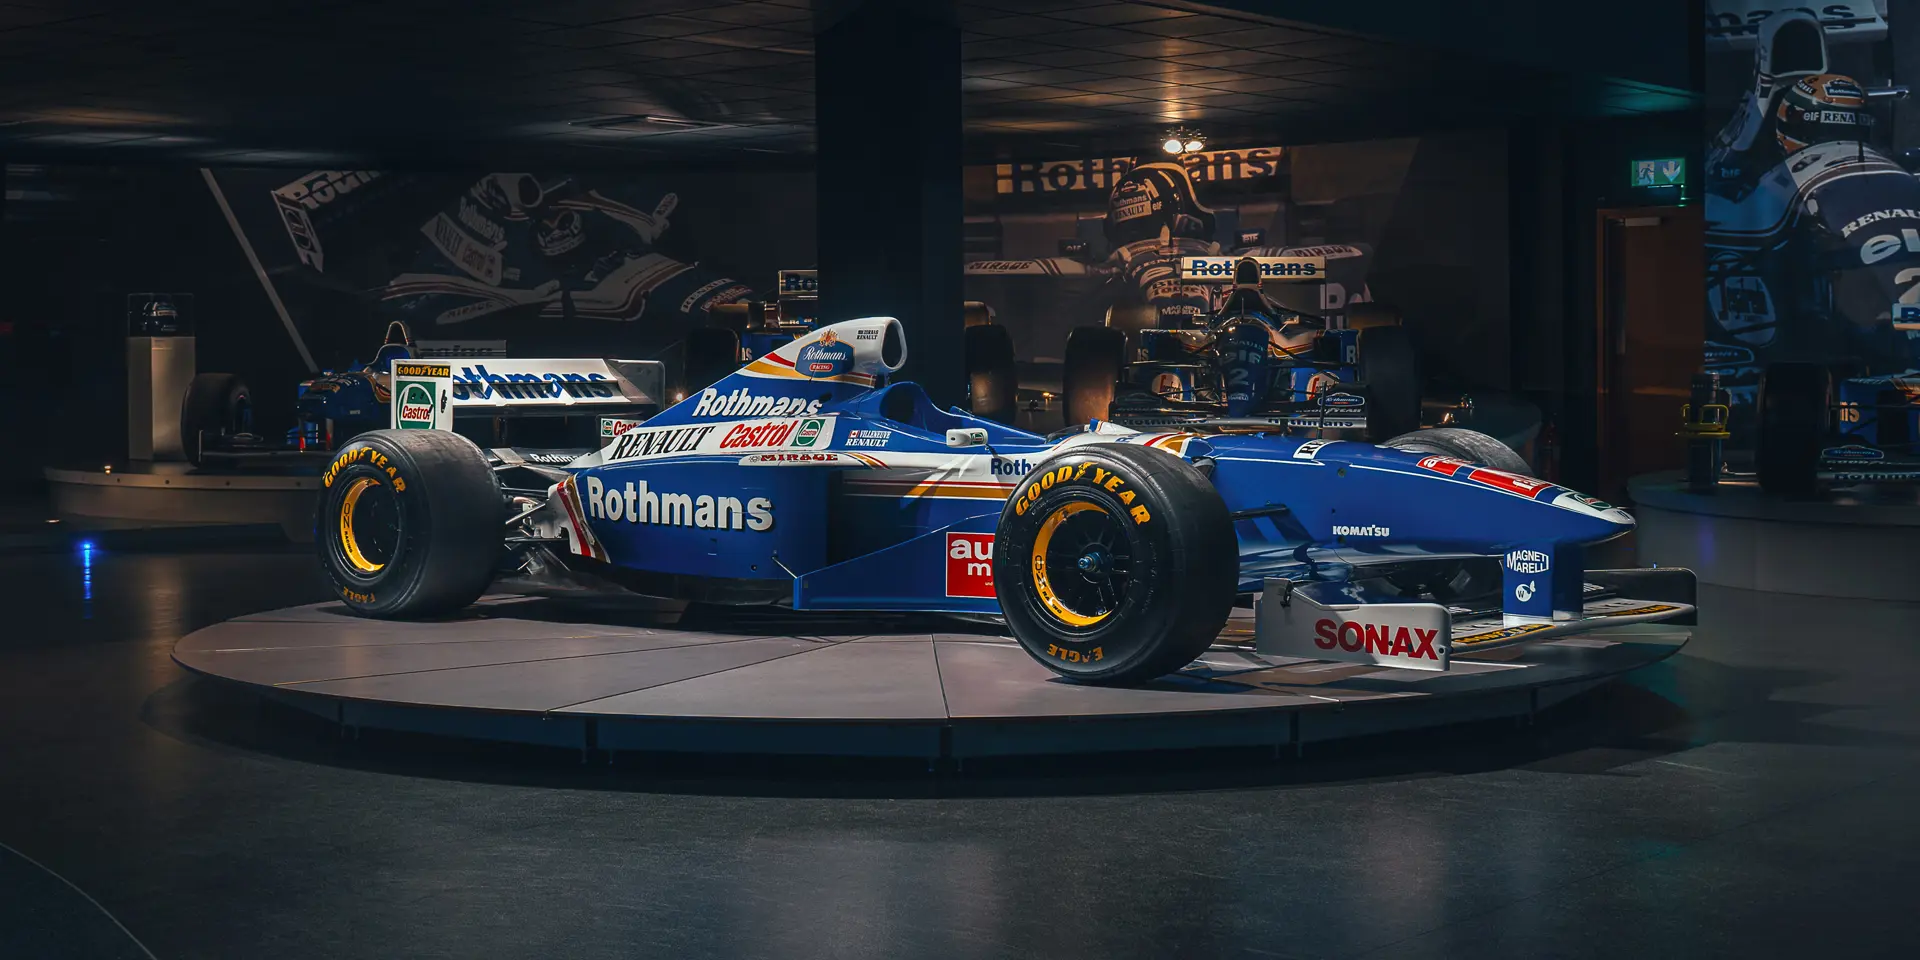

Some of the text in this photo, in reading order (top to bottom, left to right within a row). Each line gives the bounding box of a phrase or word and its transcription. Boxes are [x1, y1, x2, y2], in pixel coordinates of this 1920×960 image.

[1803, 111, 1819, 121] elf
[803, 346, 846, 361] Rothmans
[693, 386, 822, 418] Rothmans
[608, 425, 714, 461] RENAULT
[720, 419, 799, 448] Castrol
[845, 438, 889, 447] RENAULT
[760, 453, 838, 462] MIRAGE
[991, 457, 1037, 476] Roth
[587, 474, 774, 533] Rothmans
[1332, 524, 1390, 537] KOMATSU
[1506, 550, 1549, 566] MAGNETI
[1313, 618, 1440, 661] SONAX
[1046, 642, 1104, 664] EAGLE
